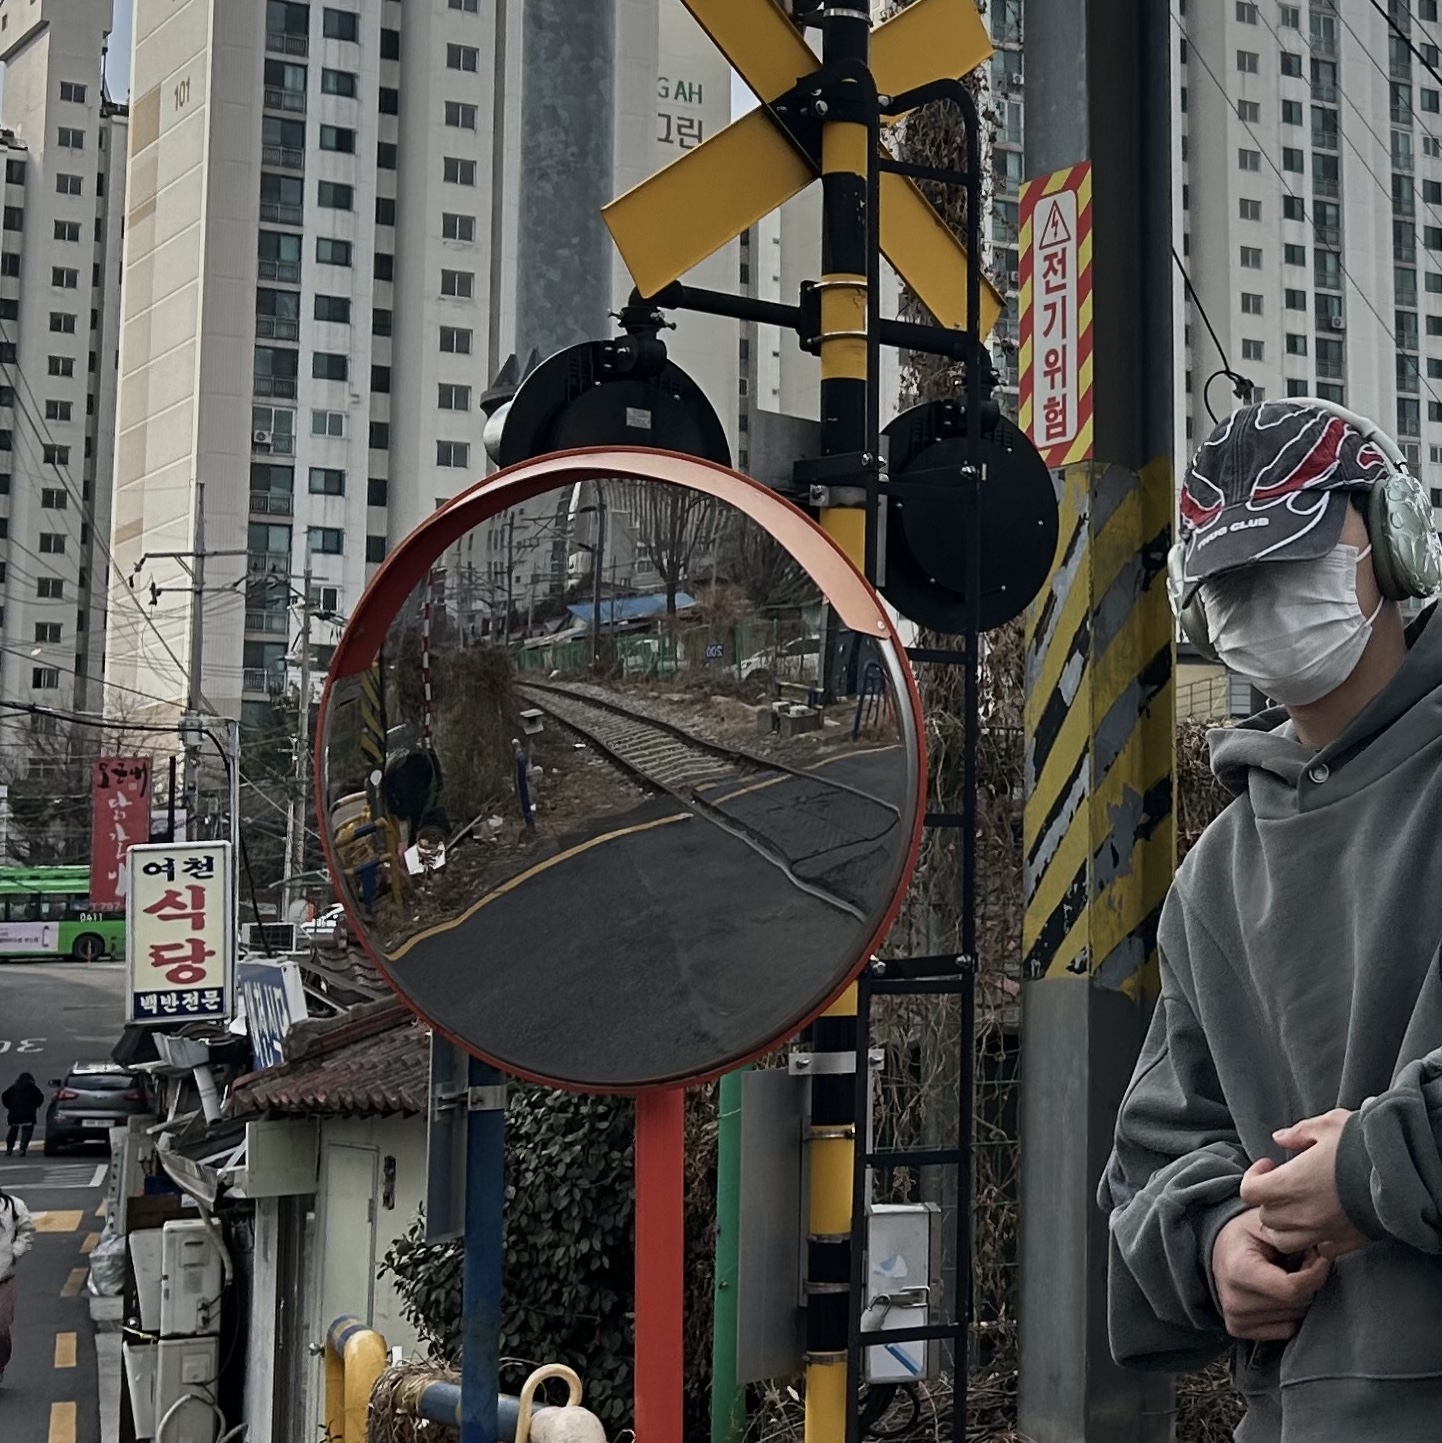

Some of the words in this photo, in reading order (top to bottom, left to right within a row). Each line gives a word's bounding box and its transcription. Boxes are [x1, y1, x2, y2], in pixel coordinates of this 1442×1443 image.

[173, 76, 191, 112] 101
[1042, 246, 1068, 442] 전기위험
[142, 855, 215, 882] 여천
[142, 884, 216, 985] 식당
[140, 989, 221, 1014] 백반전문
